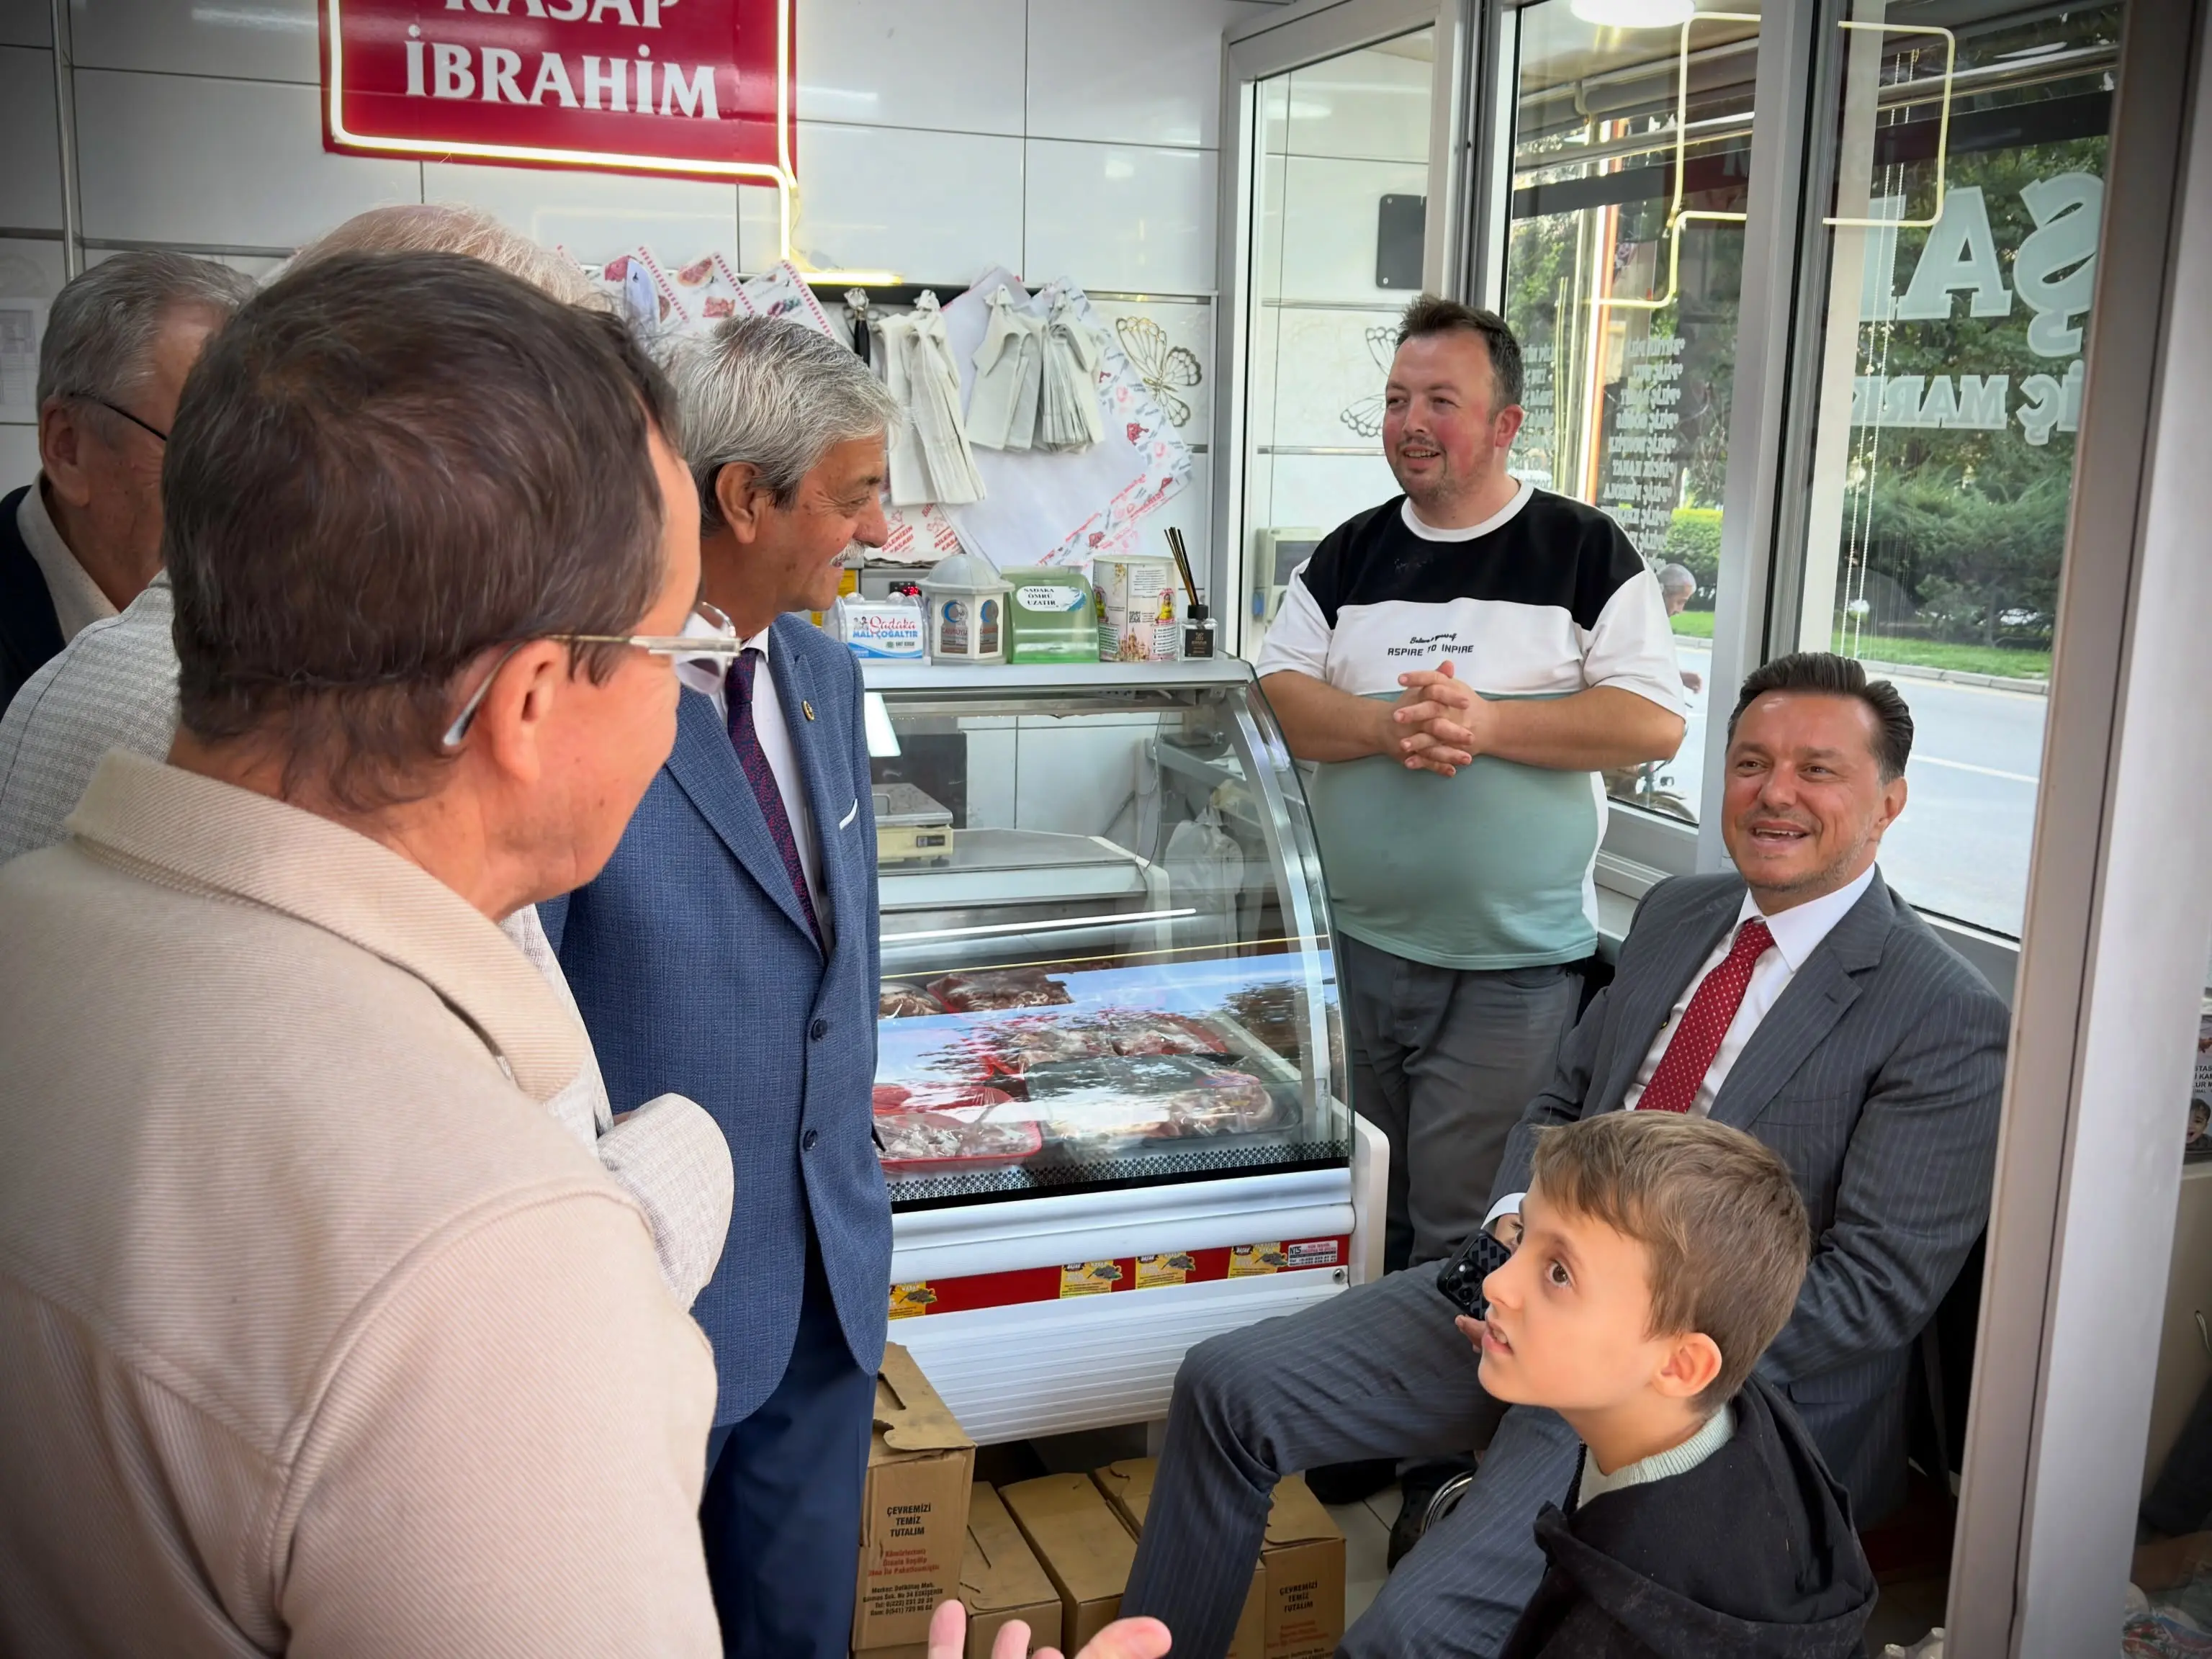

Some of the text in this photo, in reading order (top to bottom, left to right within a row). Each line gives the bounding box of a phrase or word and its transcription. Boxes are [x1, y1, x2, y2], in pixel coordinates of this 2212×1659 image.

[404, 24, 721, 120] İBRAHİM
[870, 616, 916, 634] Sadaka
[887, 1502, 931, 1517] ÇEVREMİZİ
[896, 1514, 921, 1526] TEMİZ
[890, 1527, 925, 1537] TUTALIM
